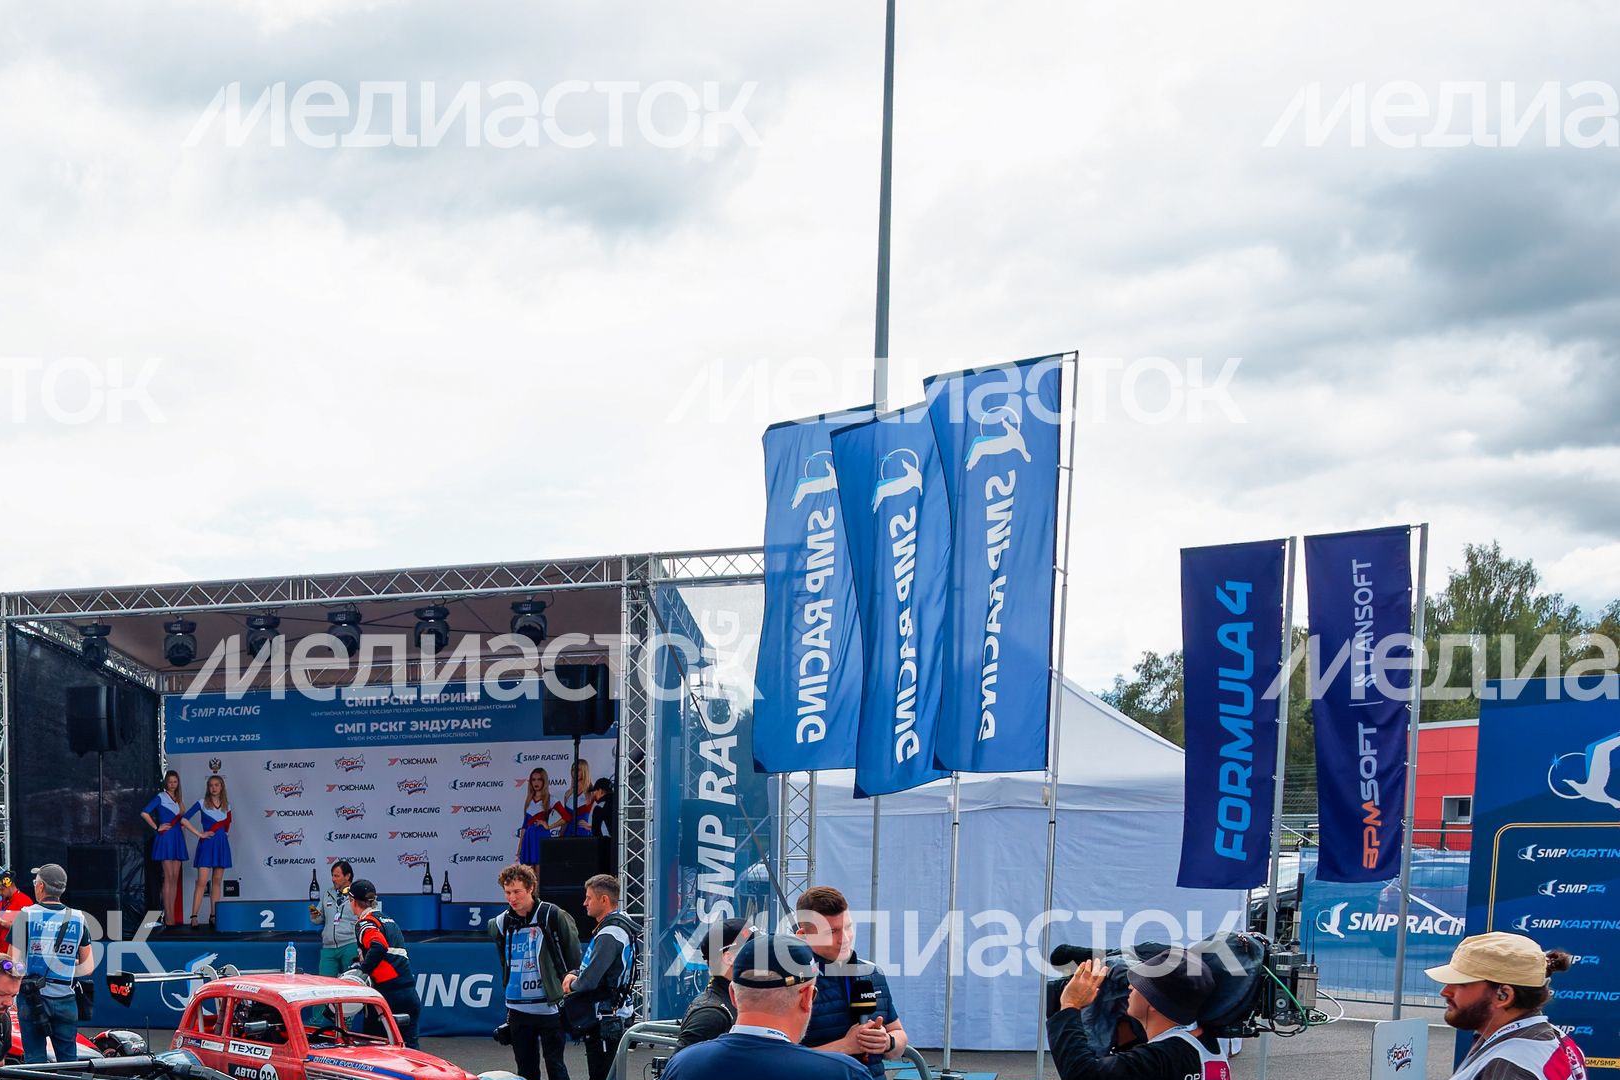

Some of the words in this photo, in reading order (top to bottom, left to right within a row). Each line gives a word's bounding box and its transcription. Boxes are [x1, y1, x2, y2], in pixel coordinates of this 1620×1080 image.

[1215, 580, 1253, 615] 4
[1352, 559, 1374, 666] LANSOFT
[345, 696, 377, 708] СМП
[381, 694, 416, 706] РСКГ
[420, 691, 481, 704] СПРИНТ
[696, 609, 740, 806] RACING
[191, 707, 216, 718] SMP
[218, 705, 260, 717] RACING
[335, 722, 366, 734] СМП
[370, 721, 405, 733] РСКГ
[410, 717, 492, 732] ЭНДУРАНС
[197, 734, 238, 743] АВГУСТА
[240, 733, 261, 741] 2025
[1213, 621, 1254, 861] FORMULA
[1357, 722, 1379, 869] BPMSOFT
[399, 831, 438, 839] YOKOHAMA
[1536, 848, 1620, 859] SMPKARTIN
[696, 813, 737, 924] SMP
[259, 909, 275, 928] 2
[468, 907, 482, 927] 3
[1348, 911, 1399, 933] SMP
[416, 974, 494, 1008] ING
[522, 979, 542, 991] 002
[231, 1043, 269, 1057] TEXOL
[234, 1066, 257, 1079] АВТО
